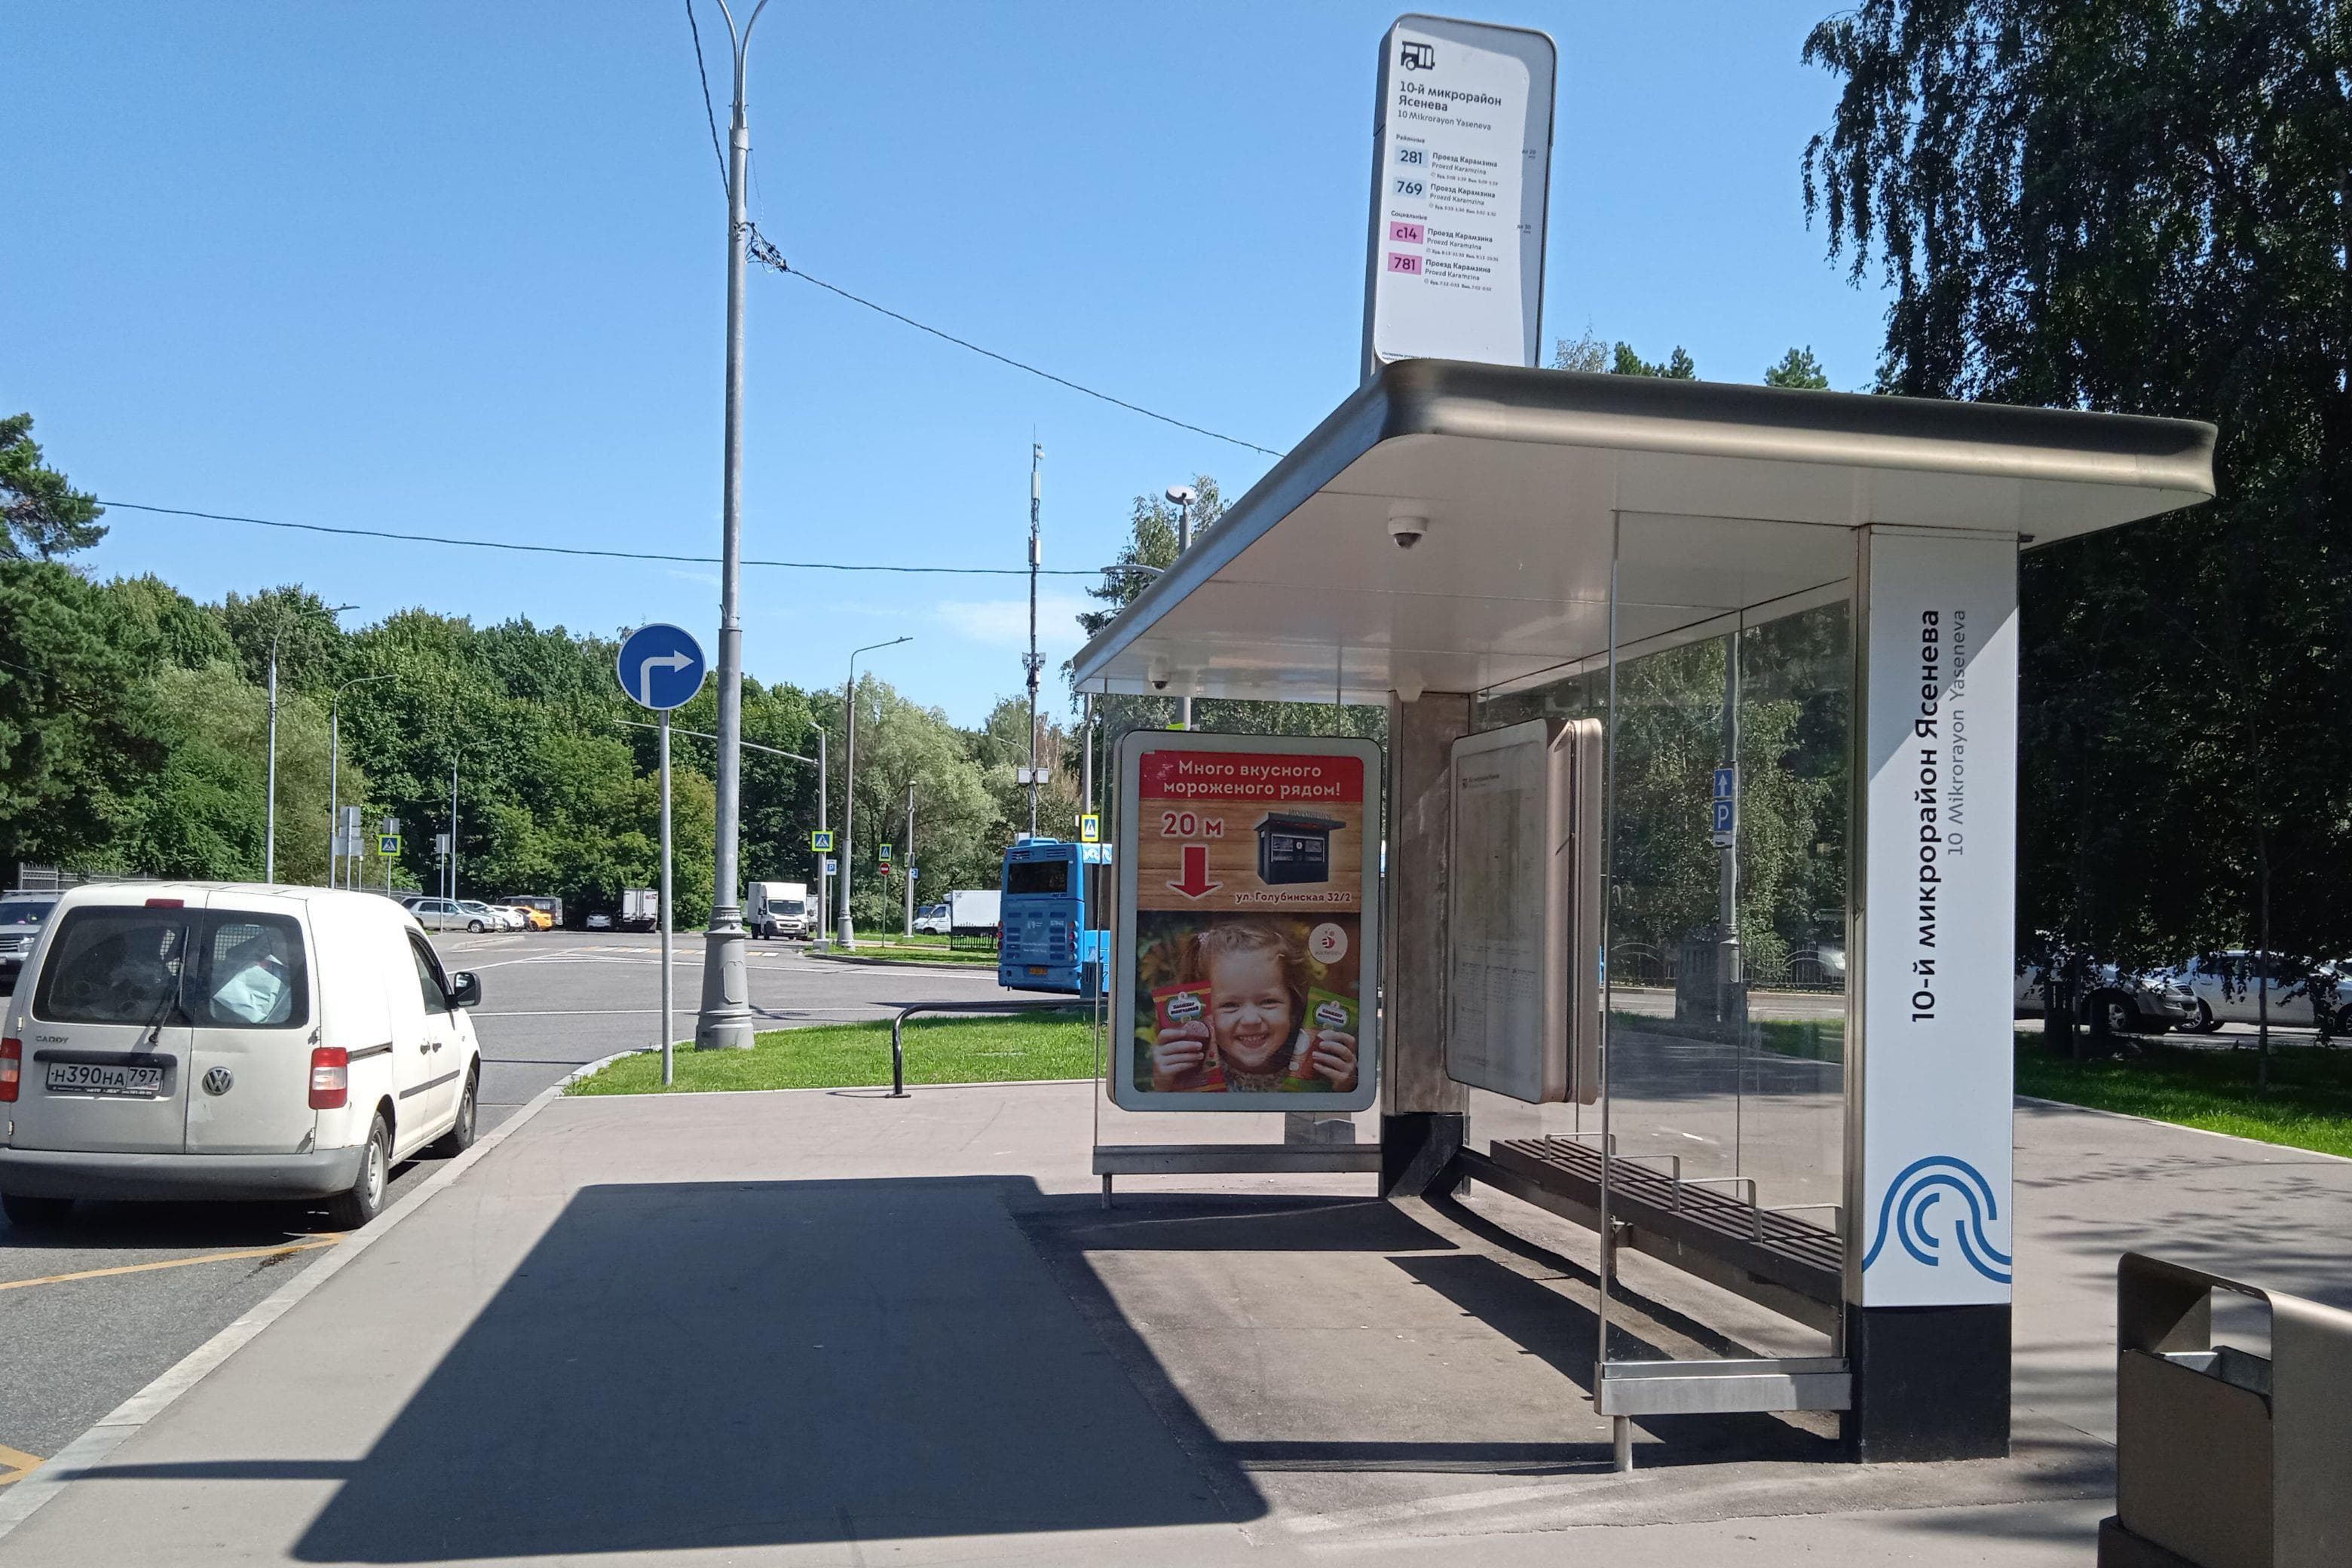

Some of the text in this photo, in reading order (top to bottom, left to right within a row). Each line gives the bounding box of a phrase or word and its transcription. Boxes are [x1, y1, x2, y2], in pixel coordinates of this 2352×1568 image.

[1400, 81, 1502, 106] 10-й микрорайон
[1399, 95, 1448, 112] Ясенева
[1398, 110, 1491, 131] 10 Mikrorayon Yaseneva
[1400, 150, 1423, 164] 281
[1432, 152, 1498, 168] Проезд Карамзина
[1432, 162, 1487, 176] Proezd Karamzina
[1397, 181, 1423, 195] 769
[1431, 183, 1496, 199] Проезд Карамзина
[1429, 193, 1484, 207] Proezd Karamzina
[1391, 210, 1428, 221] Социальные
[1428, 228, 1493, 243] Проезд Карамзина
[1427, 237, 1482, 251] Proezd Karamzina
[1395, 257, 1416, 271] 781
[1426, 259, 1491, 274] Проезд Карамзина
[1425, 268, 1480, 282] Proezd Karamzina
[1948, 609, 1967, 856] 10 Mikrorayon Yaseneva
[1178, 760, 1322, 781] Много вкусного
[1163, 781, 1341, 800] мороженого рядом!
[1718, 804, 1729, 828] P
[1912, 609, 1943, 1023] 10-й микрорайон Ясенева
[1163, 813, 1223, 835] 20 м
[1236, 891, 1352, 904] ул. Голубинская 32/2
[35, 1035, 69, 1044] CADDY
[129, 1067, 157, 1083] 797
